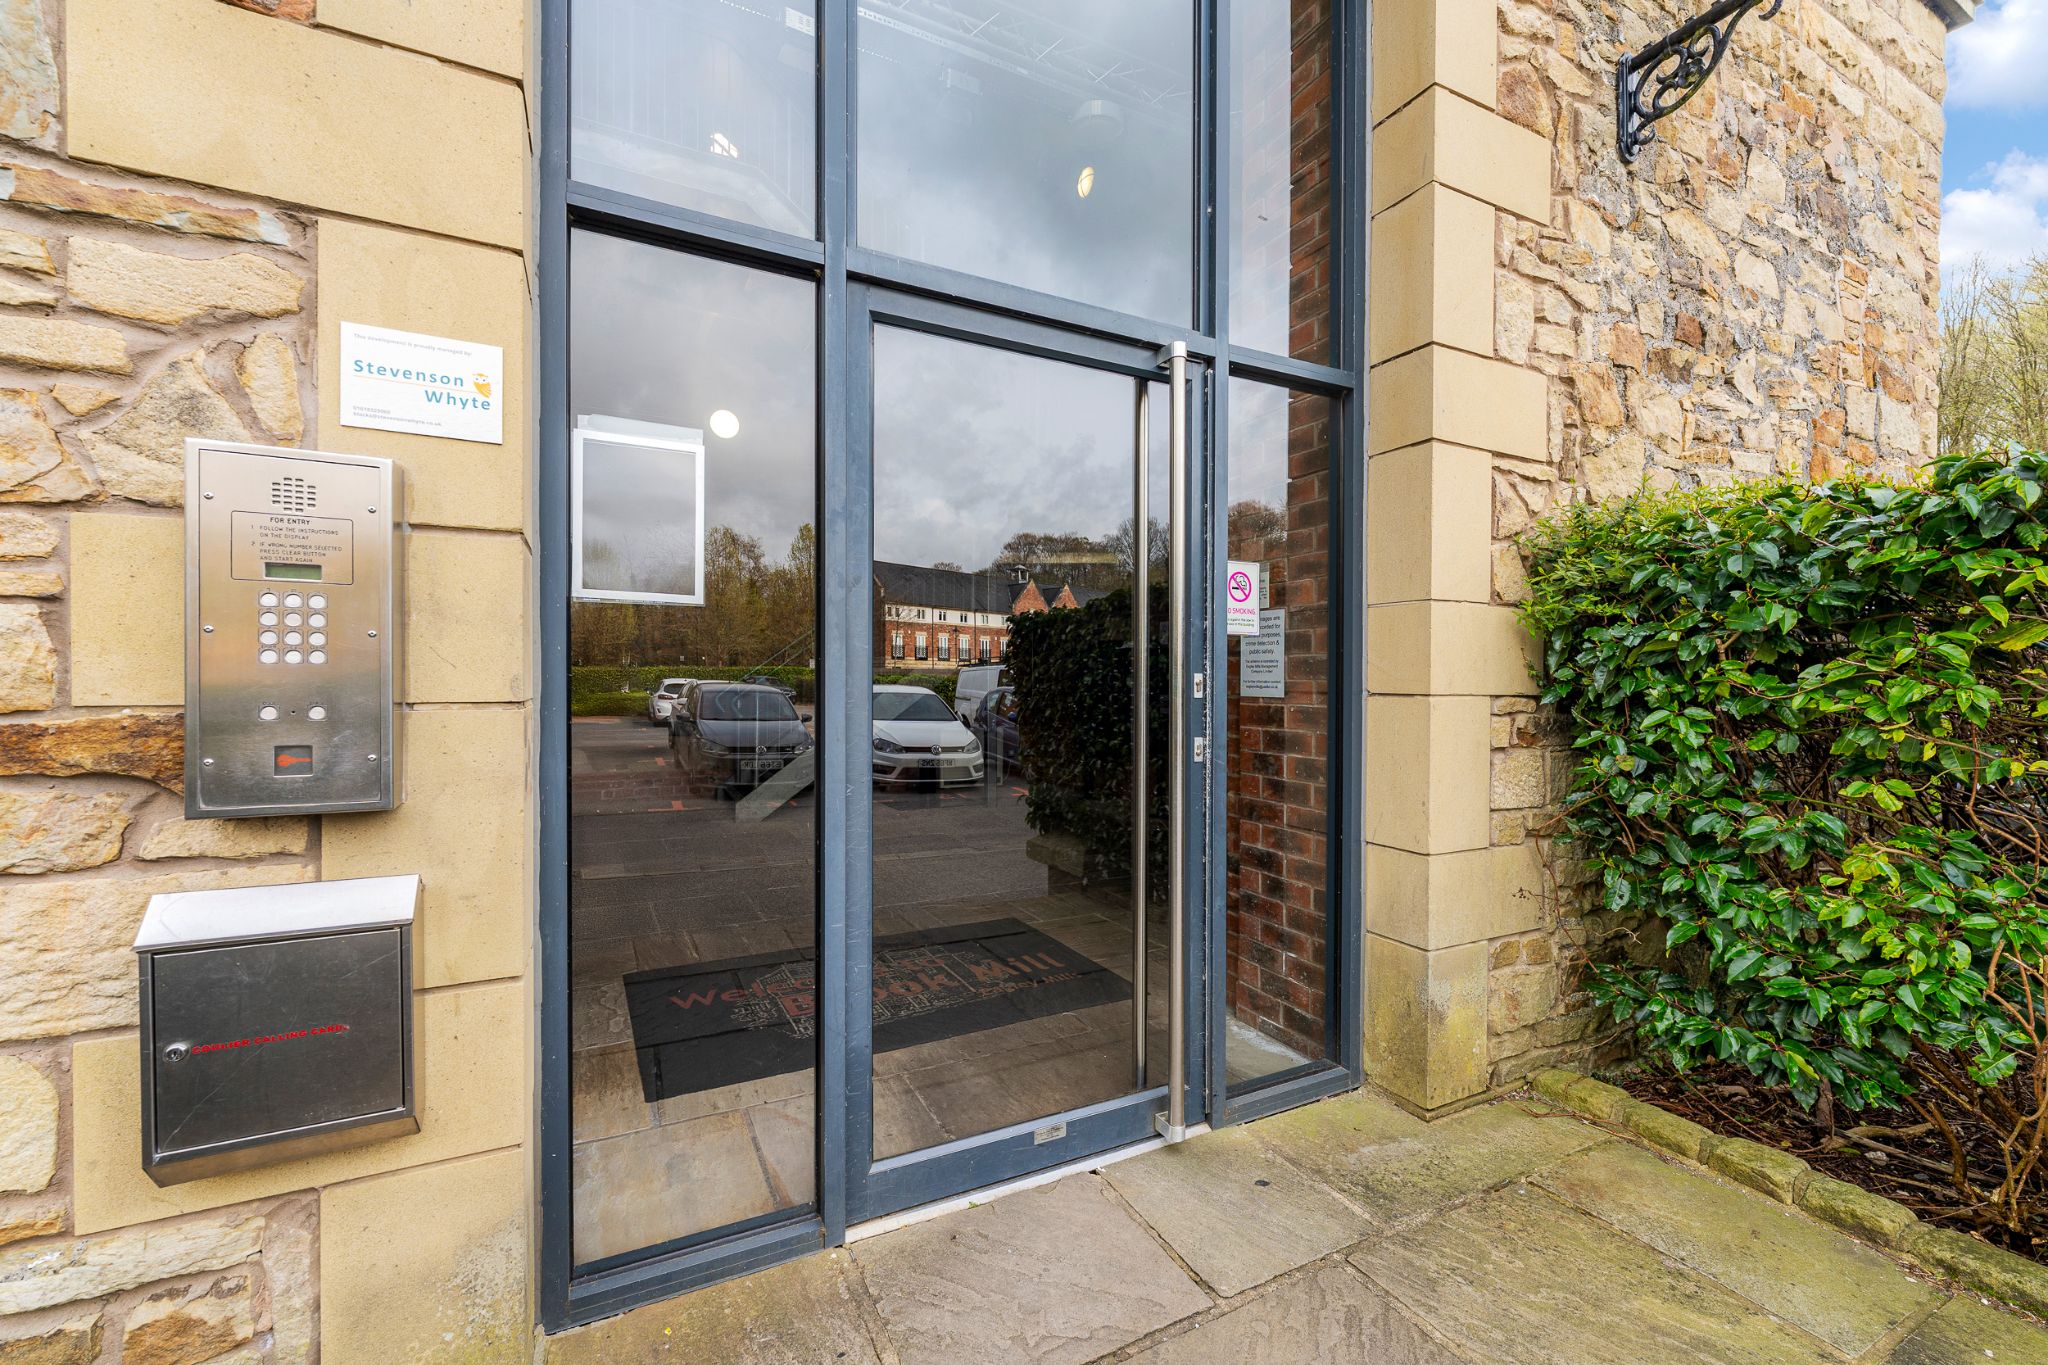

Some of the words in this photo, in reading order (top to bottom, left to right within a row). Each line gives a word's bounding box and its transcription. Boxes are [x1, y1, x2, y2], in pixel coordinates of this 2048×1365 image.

[367, 335, 407, 346] development
[413, 343, 436, 351] proudly
[437, 347, 463, 355] managed
[353, 359, 464, 388] Stevenson
[424, 389, 491, 411] Whyte
[269, 516, 285, 524] FOR
[287, 517, 311, 526] ENTRY
[298, 528, 339, 536] INSTRUCTIONS
[1232, 607, 1256, 615] SMOKING
[969, 952, 1066, 983] Mill
[254, 1029, 307, 1045] CALLING
